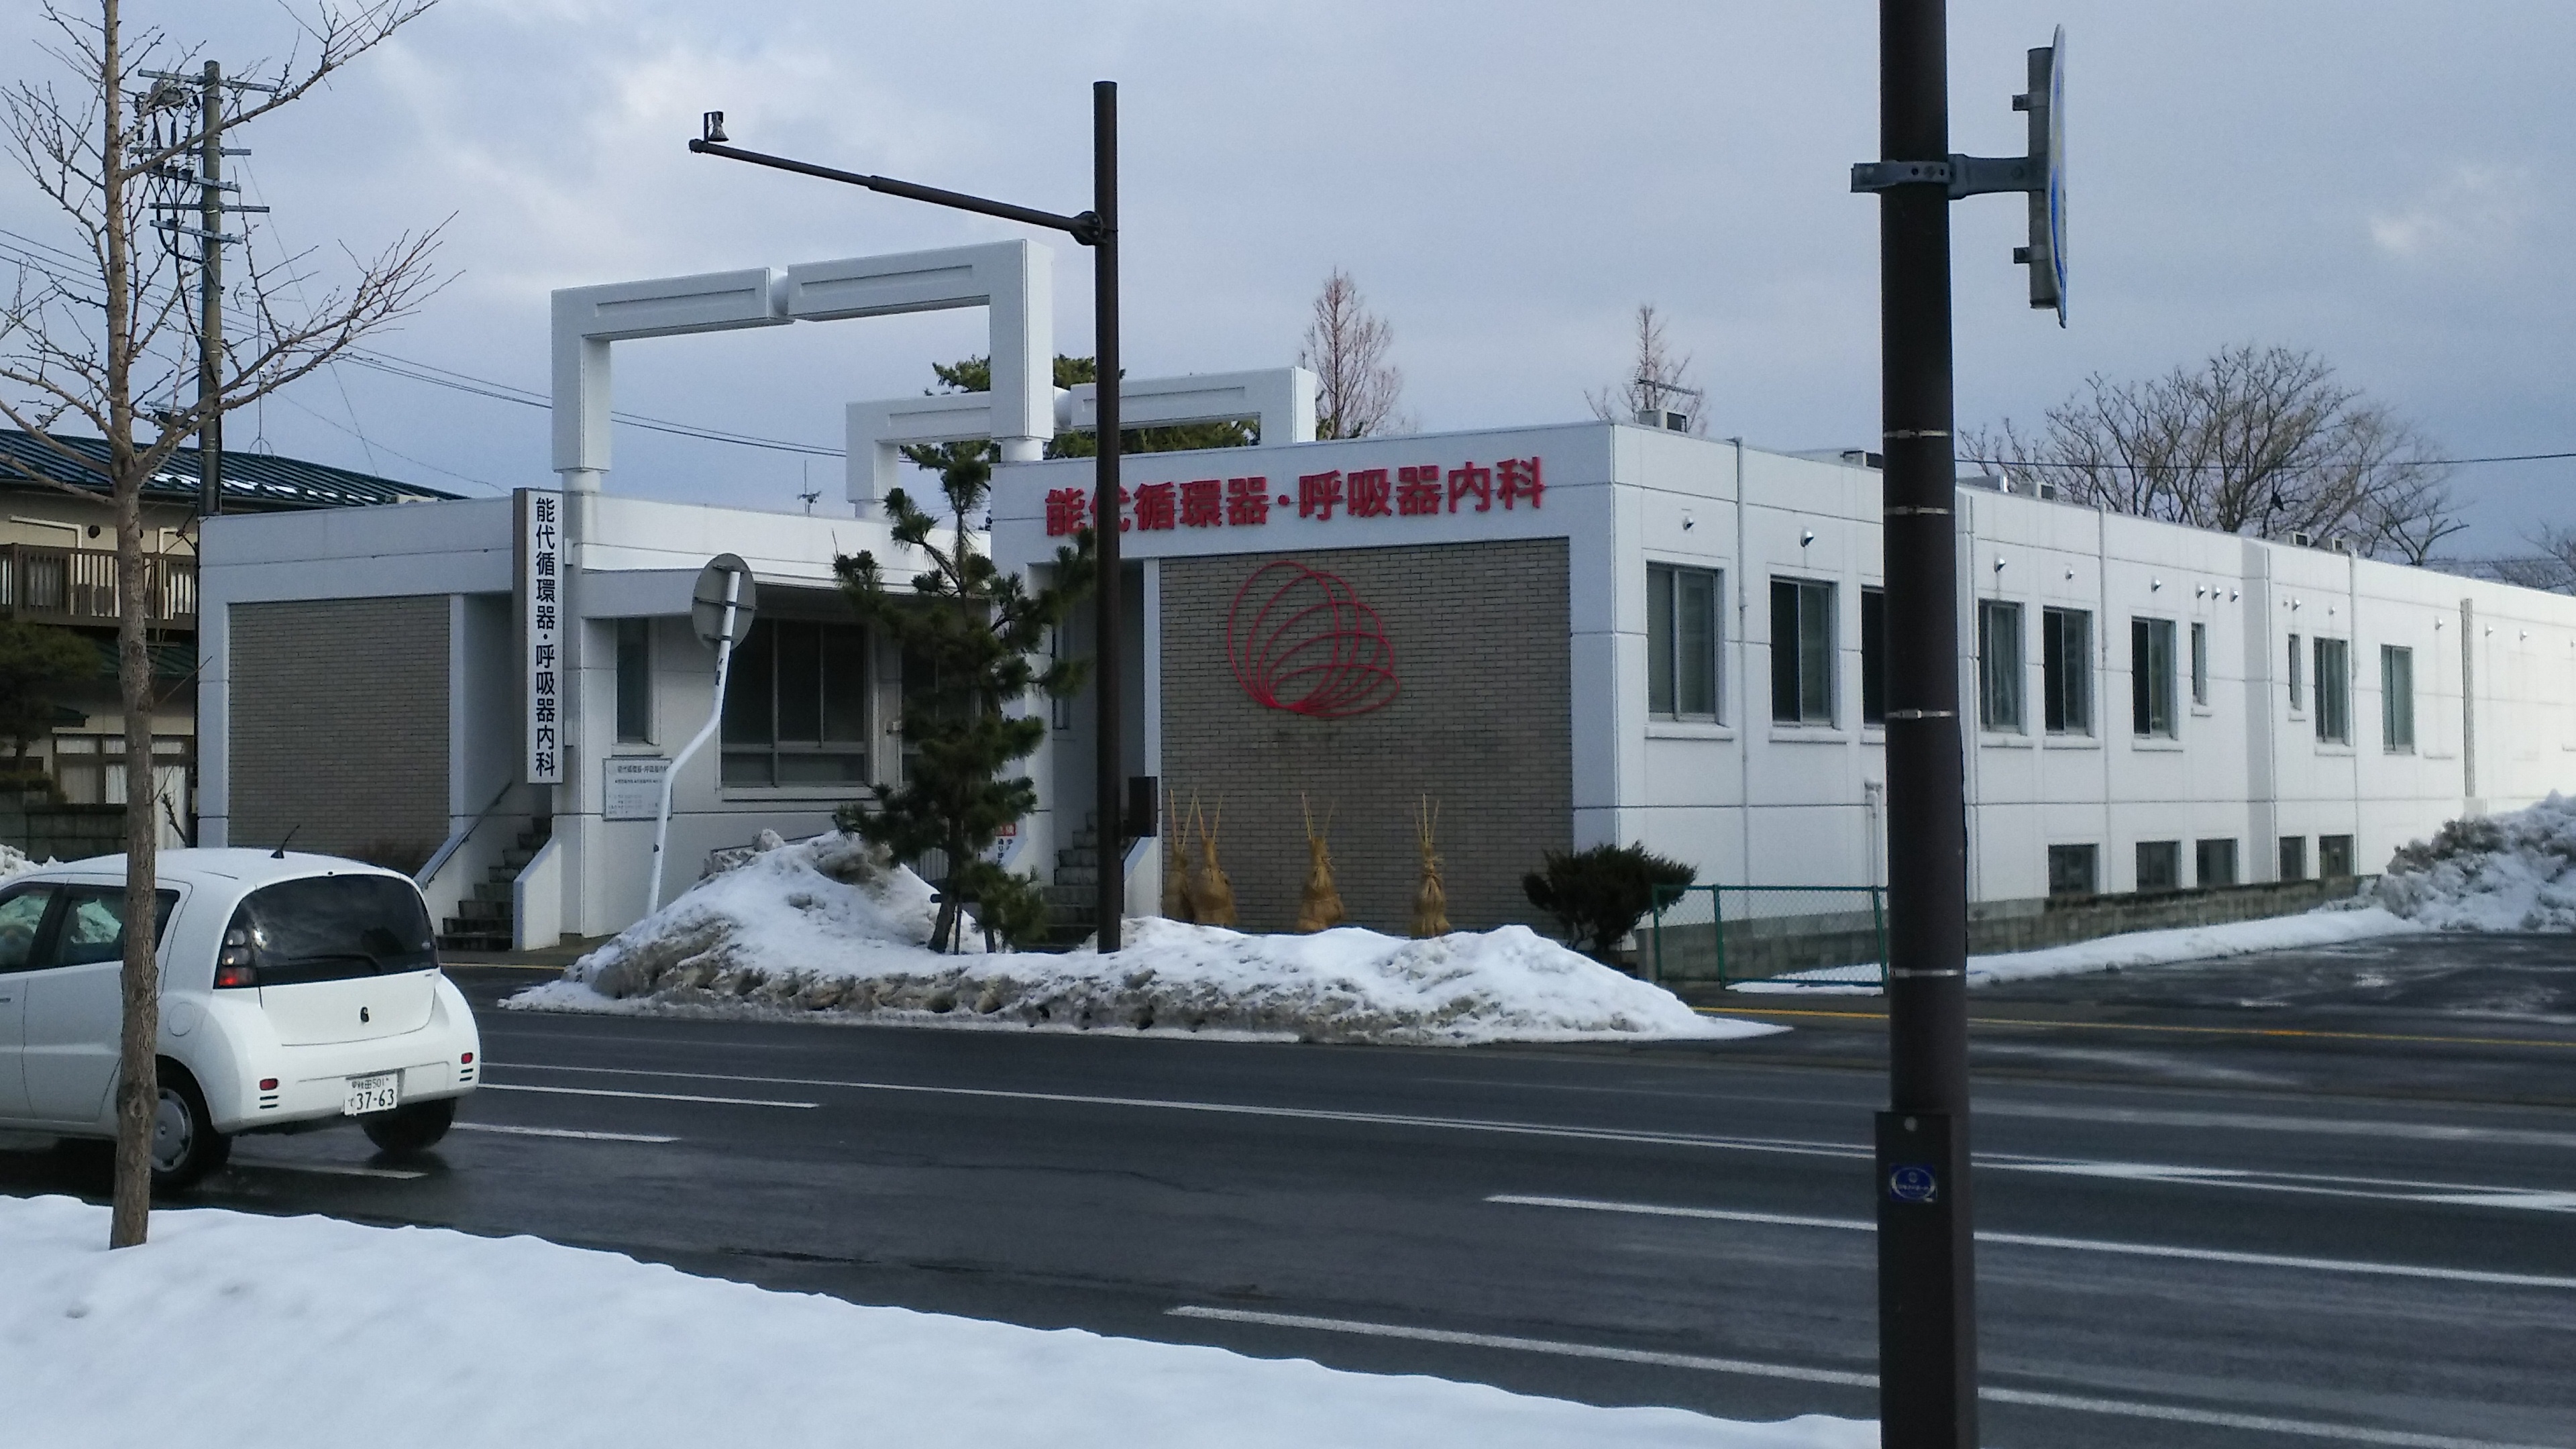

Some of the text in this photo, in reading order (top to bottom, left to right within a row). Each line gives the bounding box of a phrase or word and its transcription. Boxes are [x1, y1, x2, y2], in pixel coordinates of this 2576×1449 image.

[536, 497, 555, 777] 能代循環器・呼吸器内科
[356, 1088, 394, 1110] 37-63
